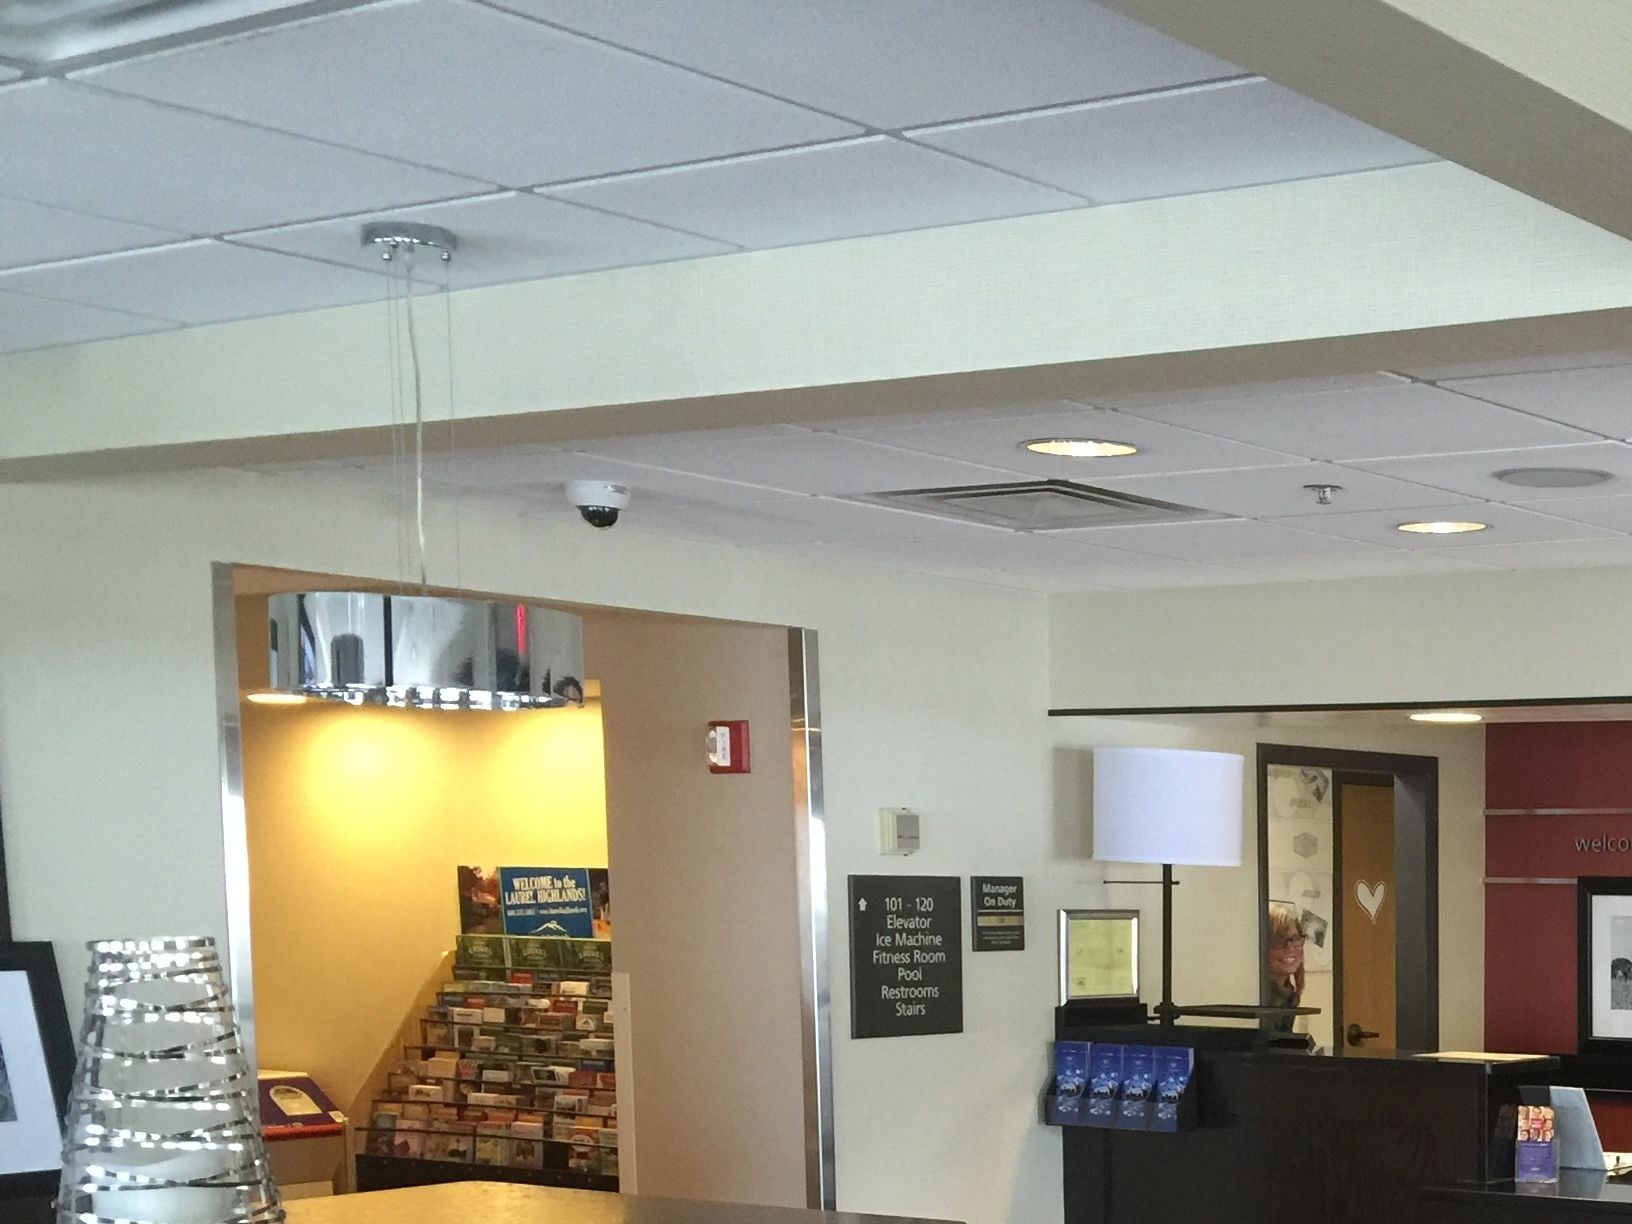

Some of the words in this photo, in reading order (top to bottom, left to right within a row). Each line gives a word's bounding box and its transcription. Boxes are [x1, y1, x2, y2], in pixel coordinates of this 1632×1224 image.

[512, 876, 553, 891] WELCOME
[554, 877, 563, 889] to
[563, 874, 577, 889] the
[982, 883, 1017, 895] Manager
[505, 890, 537, 906] LAUREL
[884, 897, 903, 912] 101
[916, 897, 934, 912] 120
[984, 896, 996, 907] On
[997, 896, 1017, 908] Duty
[886, 914, 932, 930] Elevator
[876, 933, 892, 947] Ice
[895, 932, 943, 946] Machine
[873, 950, 911, 964] Fitness
[914, 950, 946, 963] Room
[897, 967, 922, 981] Pool
[881, 985, 940, 1000] Restrooms
[895, 1001, 926, 1016] Stairs
